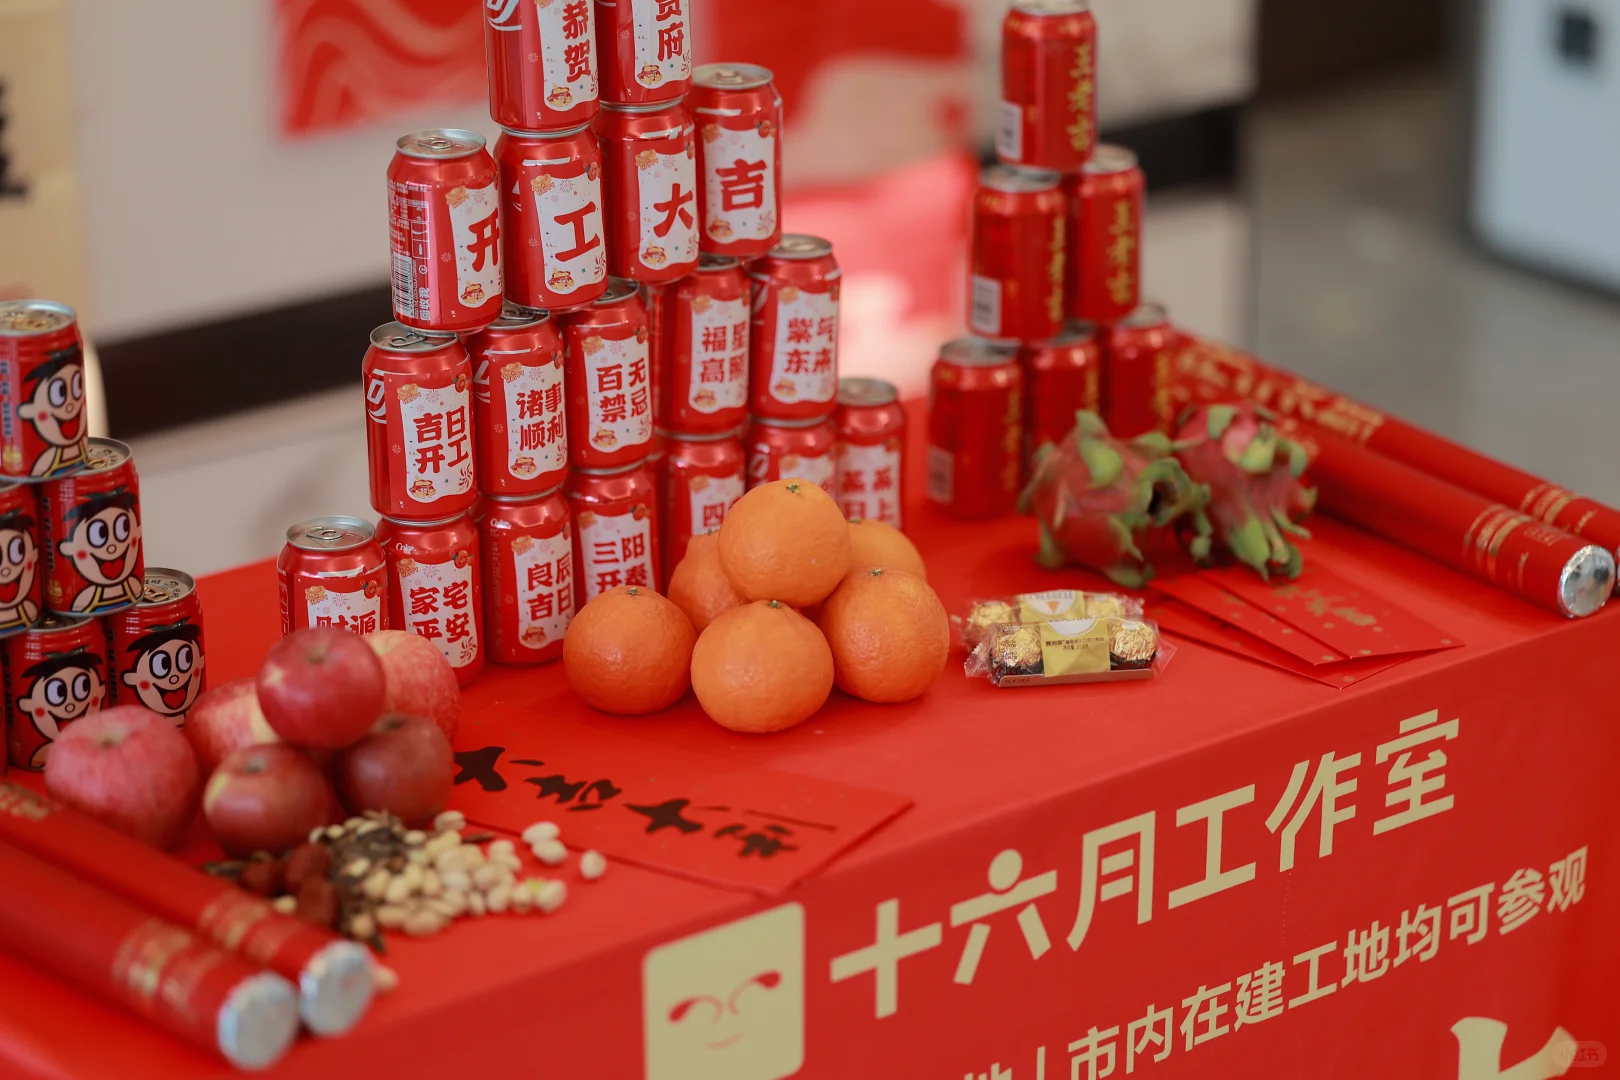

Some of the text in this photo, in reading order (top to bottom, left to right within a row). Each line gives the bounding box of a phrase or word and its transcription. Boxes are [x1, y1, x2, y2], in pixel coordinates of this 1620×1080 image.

[562, 3, 592, 83] 恭贺
[714, 157, 768, 213] 吉
[653, 183, 694, 239] 大
[553, 201, 600, 263] 工
[702, 320, 746, 353] 福星
[596, 357, 648, 393] 百无
[783, 347, 832, 374] 东来
[515, 381, 563, 420] 诸事
[599, 386, 649, 424] 禁忌
[412, 405, 466, 443] 吉日
[519, 410, 564, 452] 顺利
[414, 434, 469, 474] 开工
[592, 532, 645, 564] 三阳
[527, 550, 571, 591] 良辰
[409, 579, 469, 615] 家宅
[527, 582, 572, 621] 吉日
[412, 612, 470, 644] 平安
[830, 708, 1460, 1020] 十六月工作室
[1067, 845, 1588, 1080] 市内在建工地均可参观
